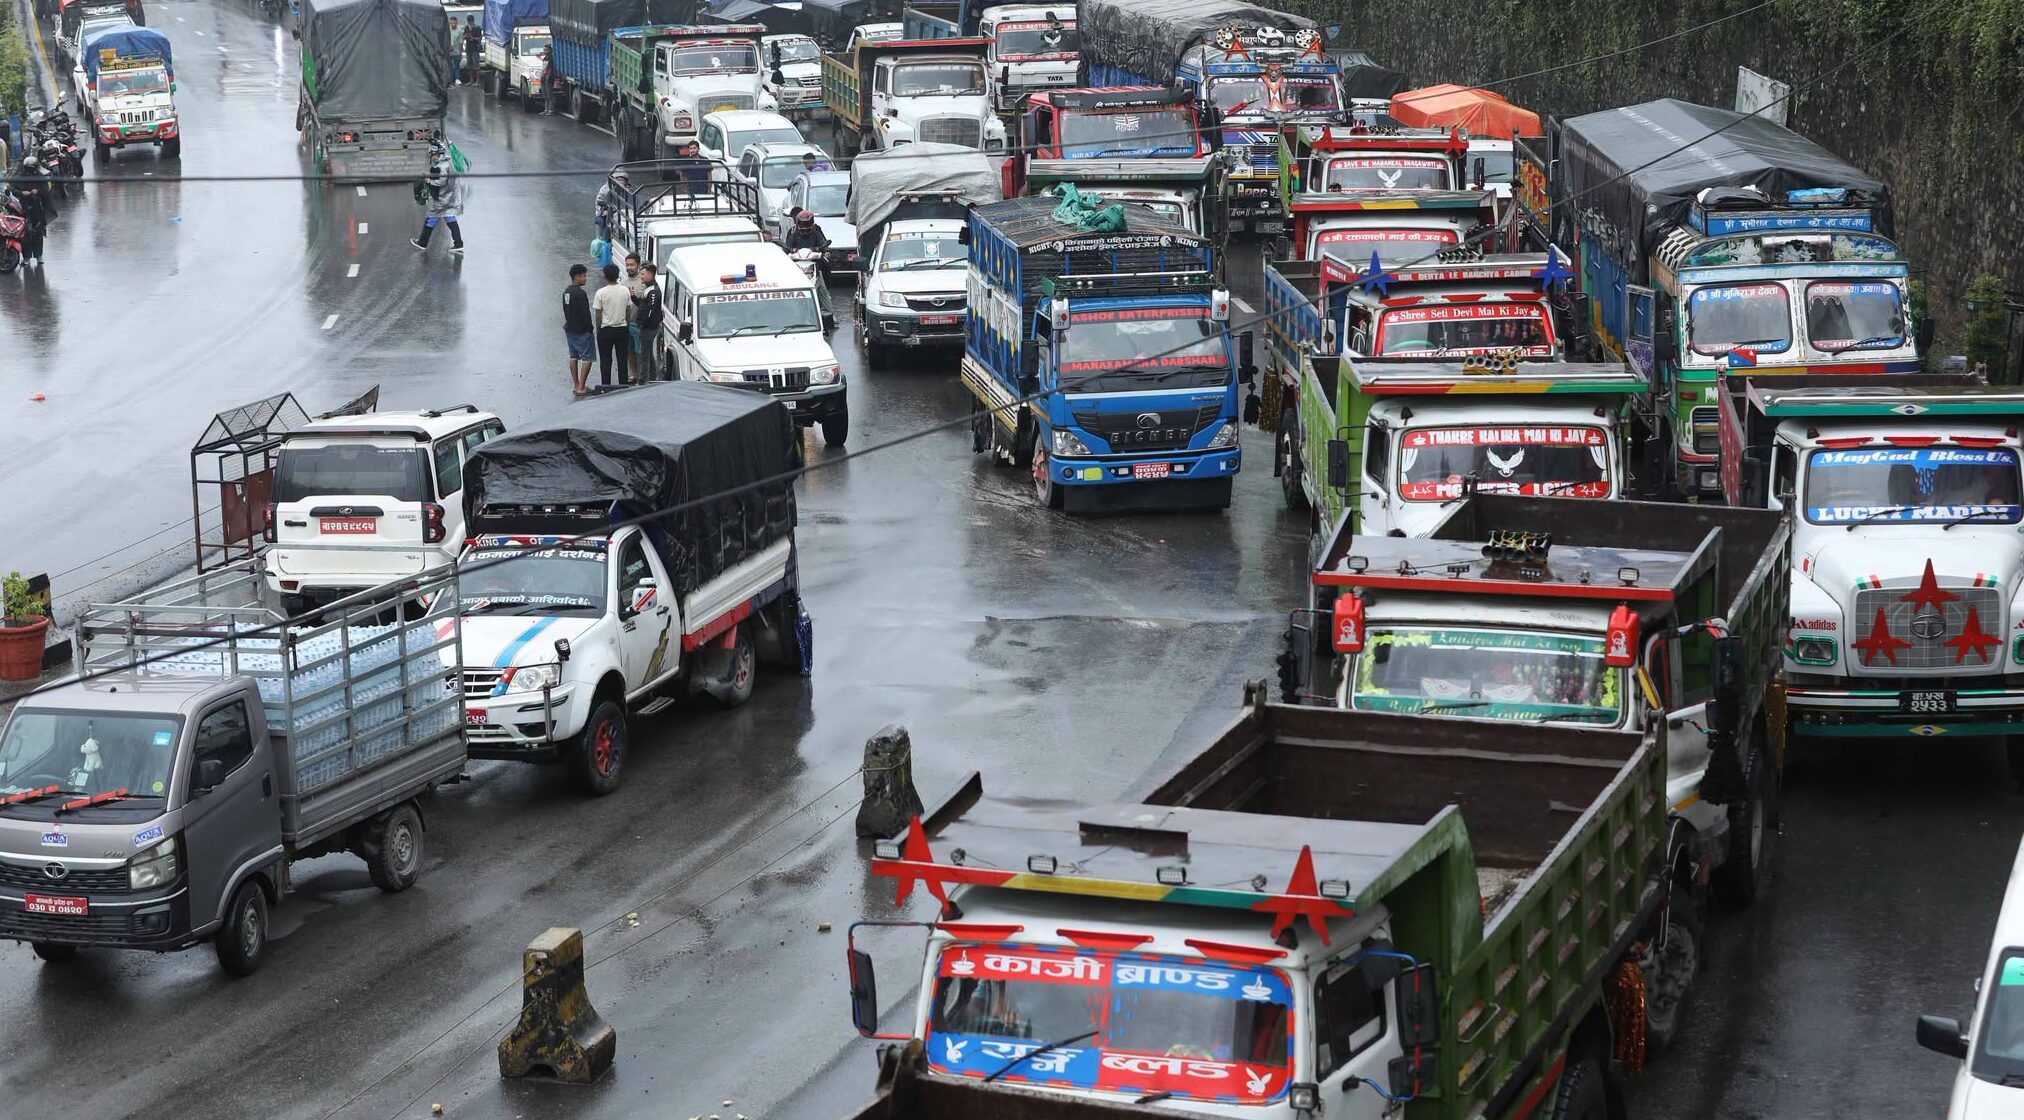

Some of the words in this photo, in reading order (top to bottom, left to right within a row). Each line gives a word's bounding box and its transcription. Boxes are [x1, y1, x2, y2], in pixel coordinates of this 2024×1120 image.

[1400, 311, 1426, 320] Shree
[1431, 308, 1448, 319] Seti
[1453, 307, 1474, 318] Devi
[1478, 306, 1495, 317] Mai
[1500, 306, 1510, 316] Ki
[1513, 305, 1529, 317] Jay
[1161, 356, 1217, 367] DARSHAN
[1525, 429, 1546, 443] MAI
[1564, 429, 1587, 443] JAY
[1533, 482, 1576, 497] LOVE
[1818, 506, 1907, 521] LUCKY
[1911, 506, 2009, 520] MADAM
[475, 538, 500, 548] KING
[529, 537, 544, 545] OF
[1808, 619, 1837, 631] adidas
[43, 834, 66, 845] AQUA
[134, 826, 161, 844] AQUA
[983, 953, 1105, 981] काजी
[1116, 963, 1236, 991] ब्राण्ड
[1101, 1051, 1239, 1080] ब्लड
